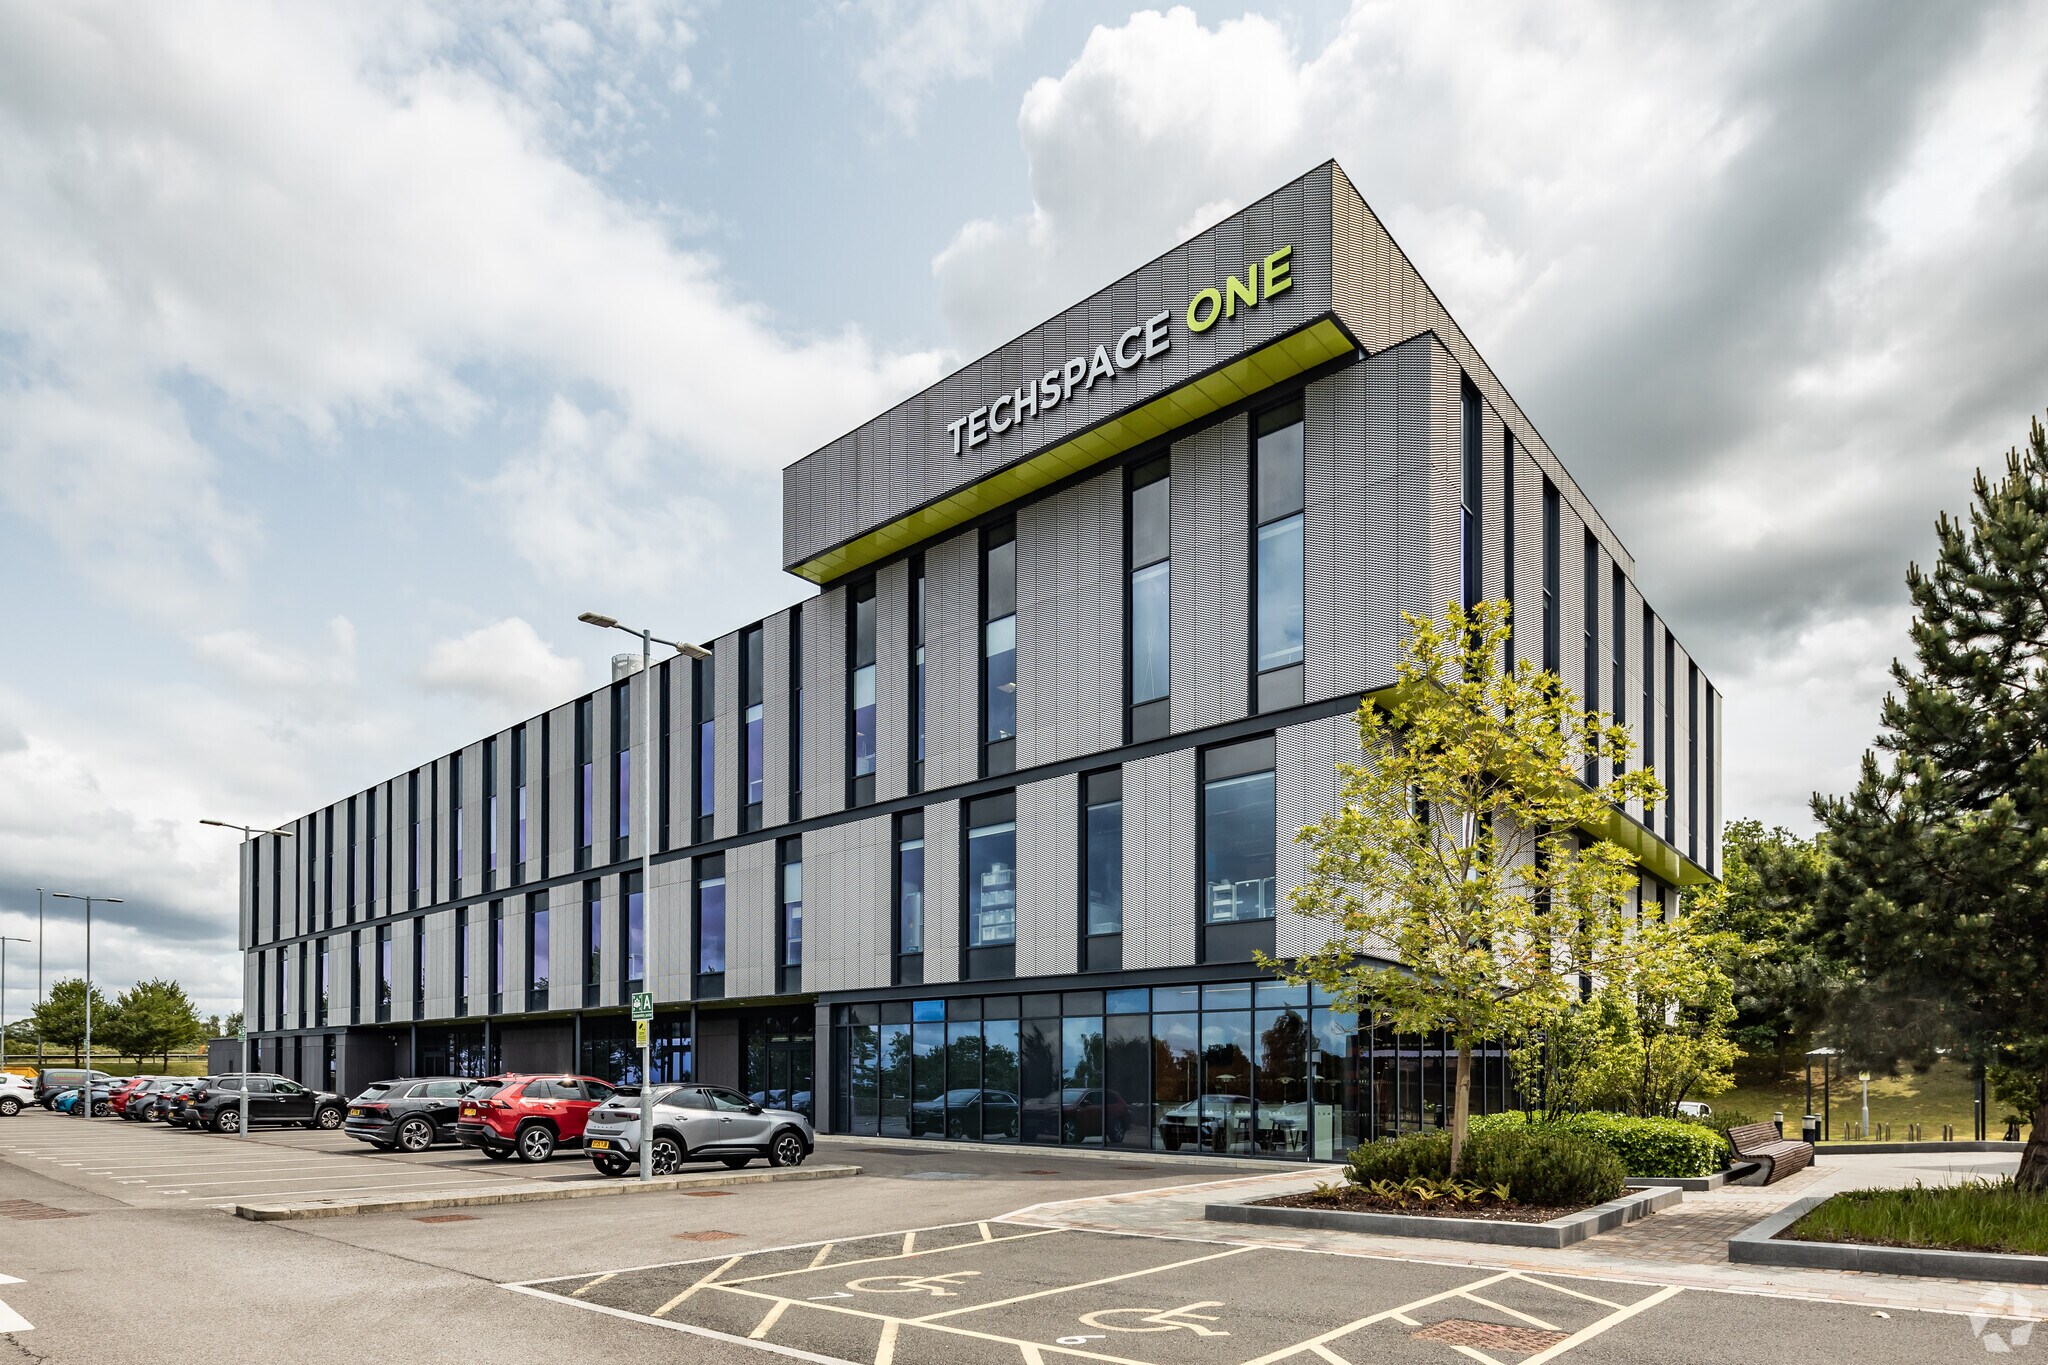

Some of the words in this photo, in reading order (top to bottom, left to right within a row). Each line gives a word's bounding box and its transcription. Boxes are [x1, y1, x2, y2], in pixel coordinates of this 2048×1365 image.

[947, 309, 1171, 455] TECHSPACE
[1186, 244, 1293, 333] ONE
[643, 994, 651, 1010] A
[1055, 1334, 1107, 1345] 6
